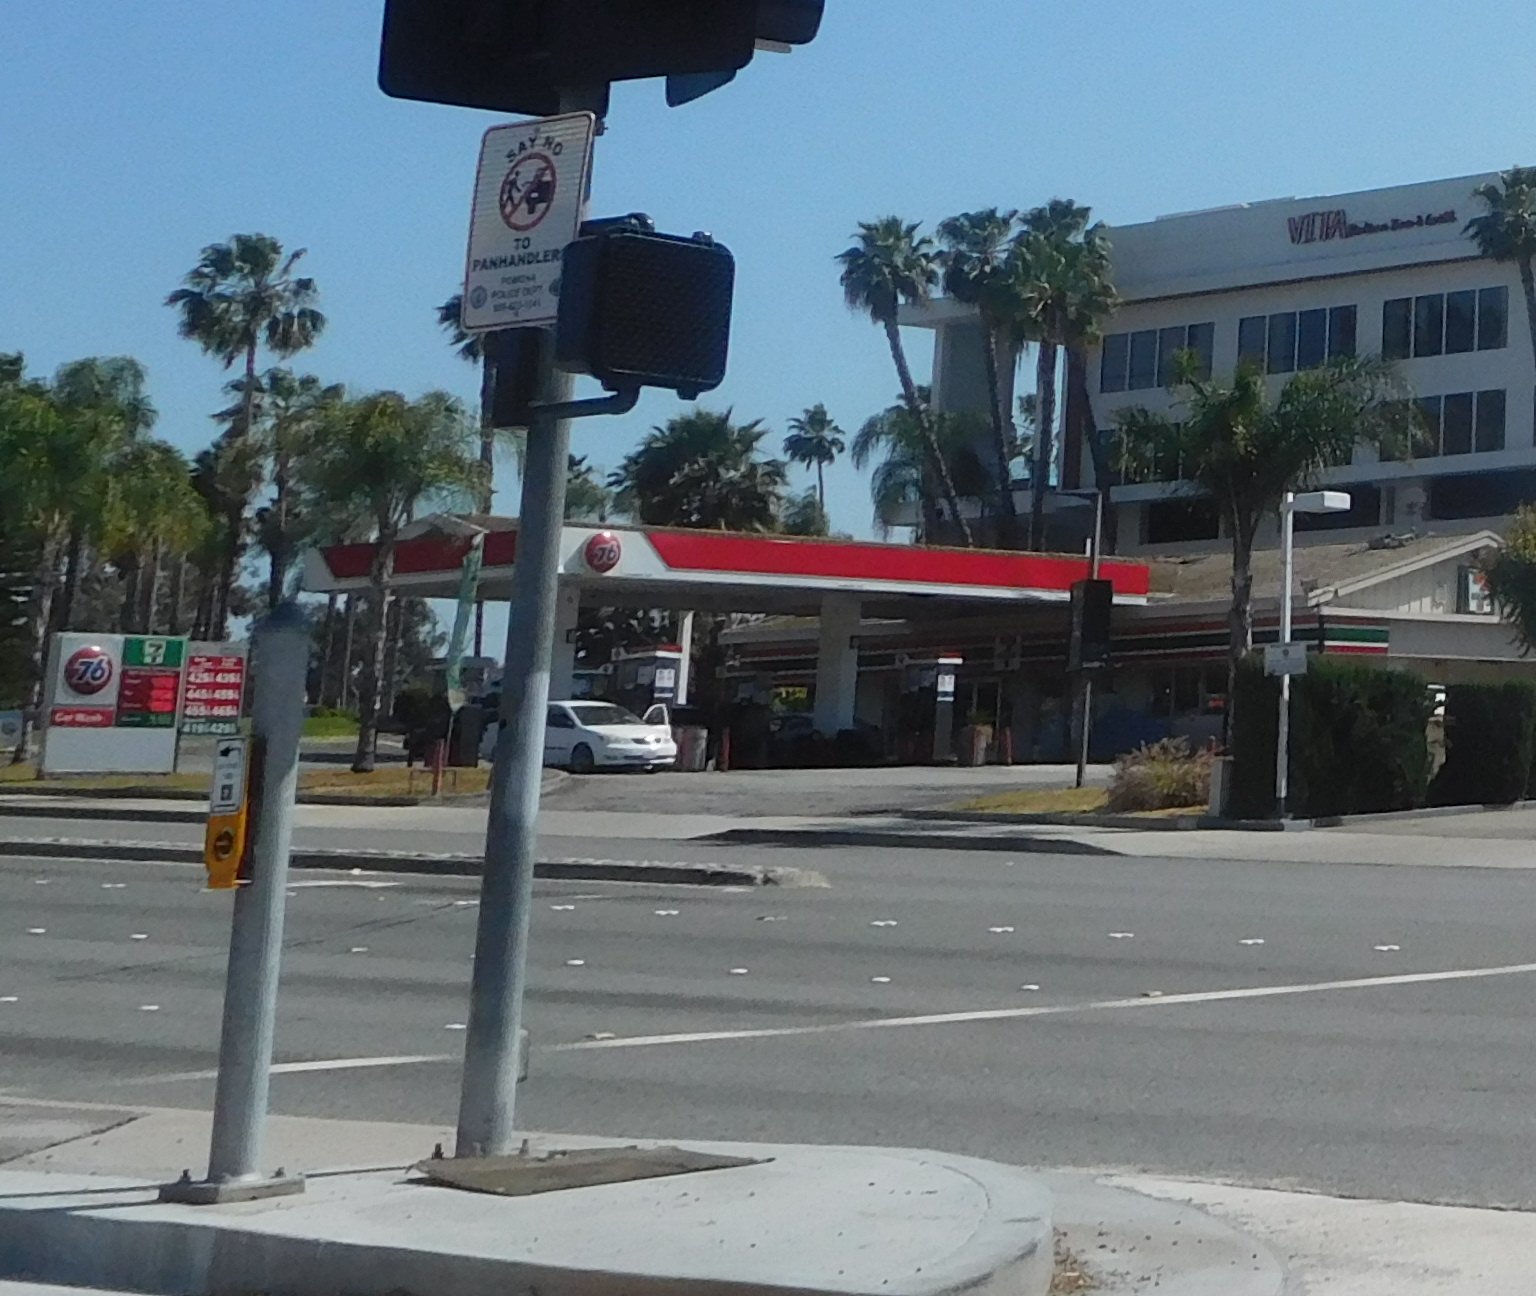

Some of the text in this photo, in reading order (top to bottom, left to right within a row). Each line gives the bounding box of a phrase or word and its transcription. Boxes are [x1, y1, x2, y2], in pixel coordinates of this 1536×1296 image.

[505, 135, 564, 164] SAY NO
[513, 237, 531, 250] TO
[472, 249, 561, 271] PANHANDLER
[594, 541, 617, 564] 76
[73, 656, 110, 684] 76
[54, 712, 74, 723] Car
